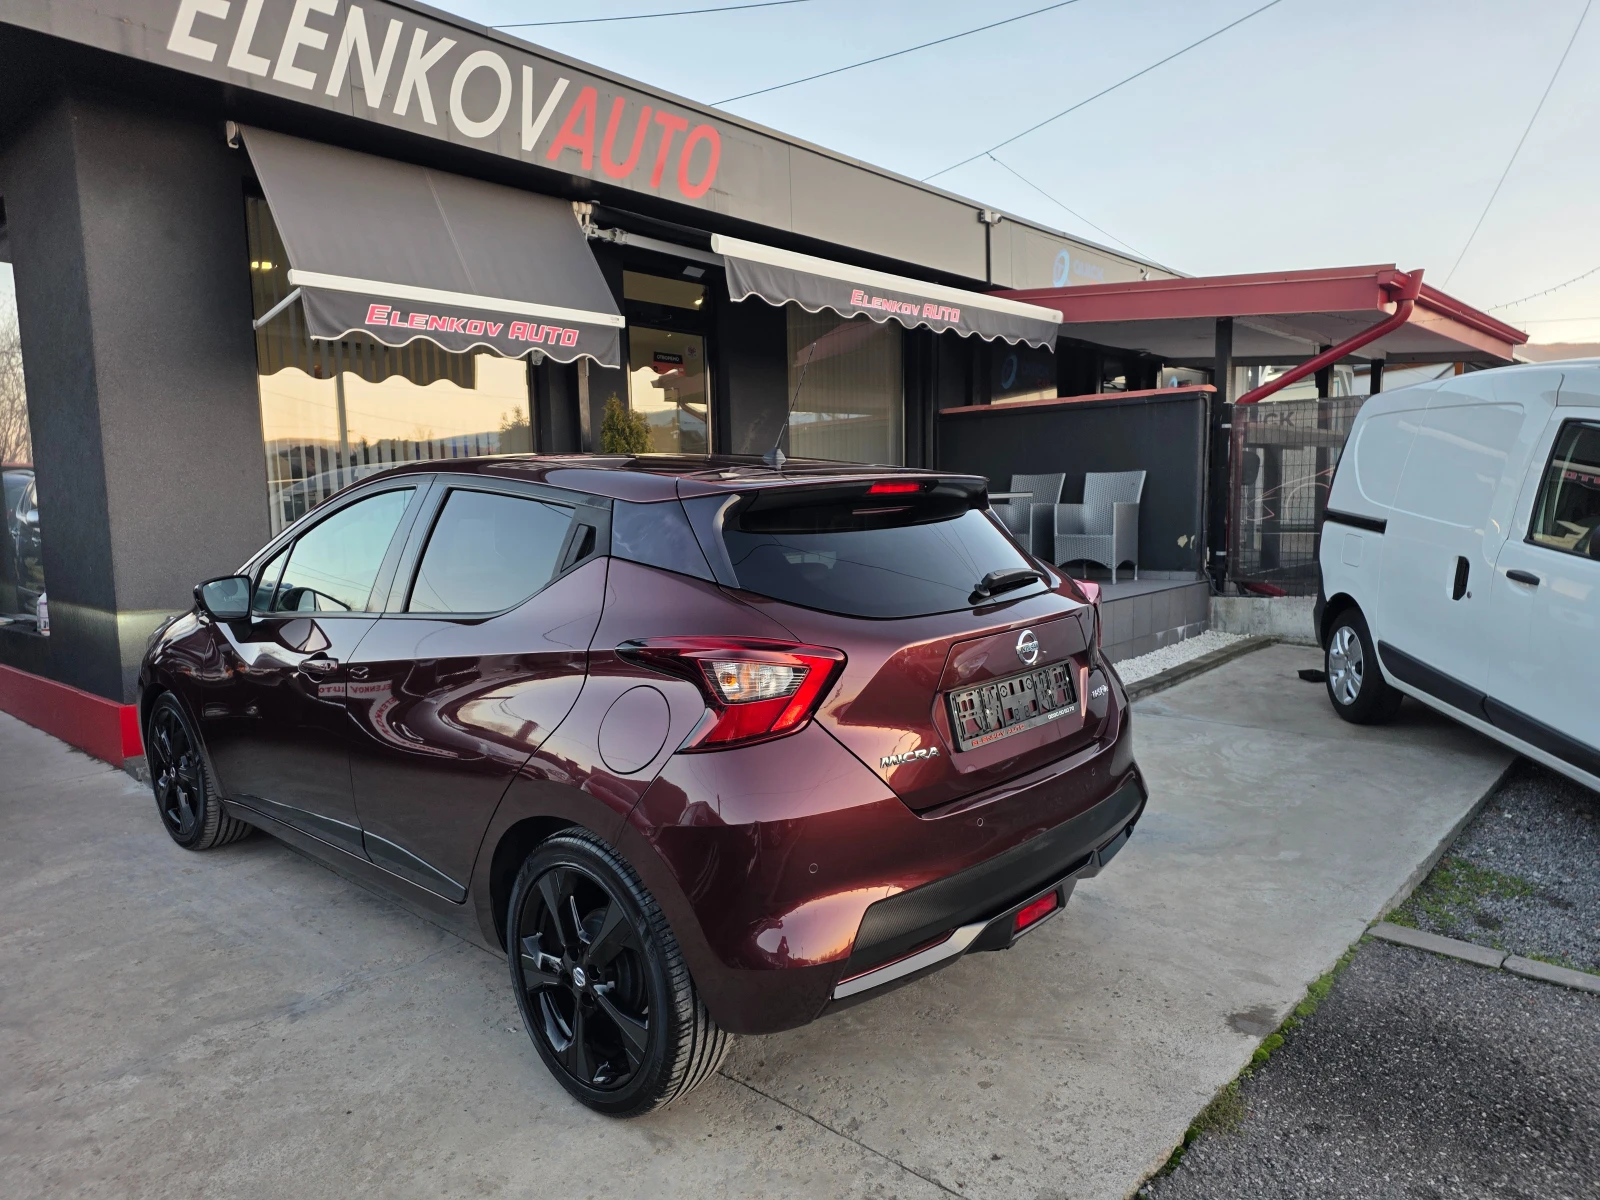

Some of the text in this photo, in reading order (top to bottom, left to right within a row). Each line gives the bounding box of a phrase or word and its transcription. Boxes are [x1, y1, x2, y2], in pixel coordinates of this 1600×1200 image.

[850, 289, 961, 323] ELENKOV AUTO
[365, 303, 580, 347] ELENKOV AUTO
[880, 746, 940, 768] MICRA
